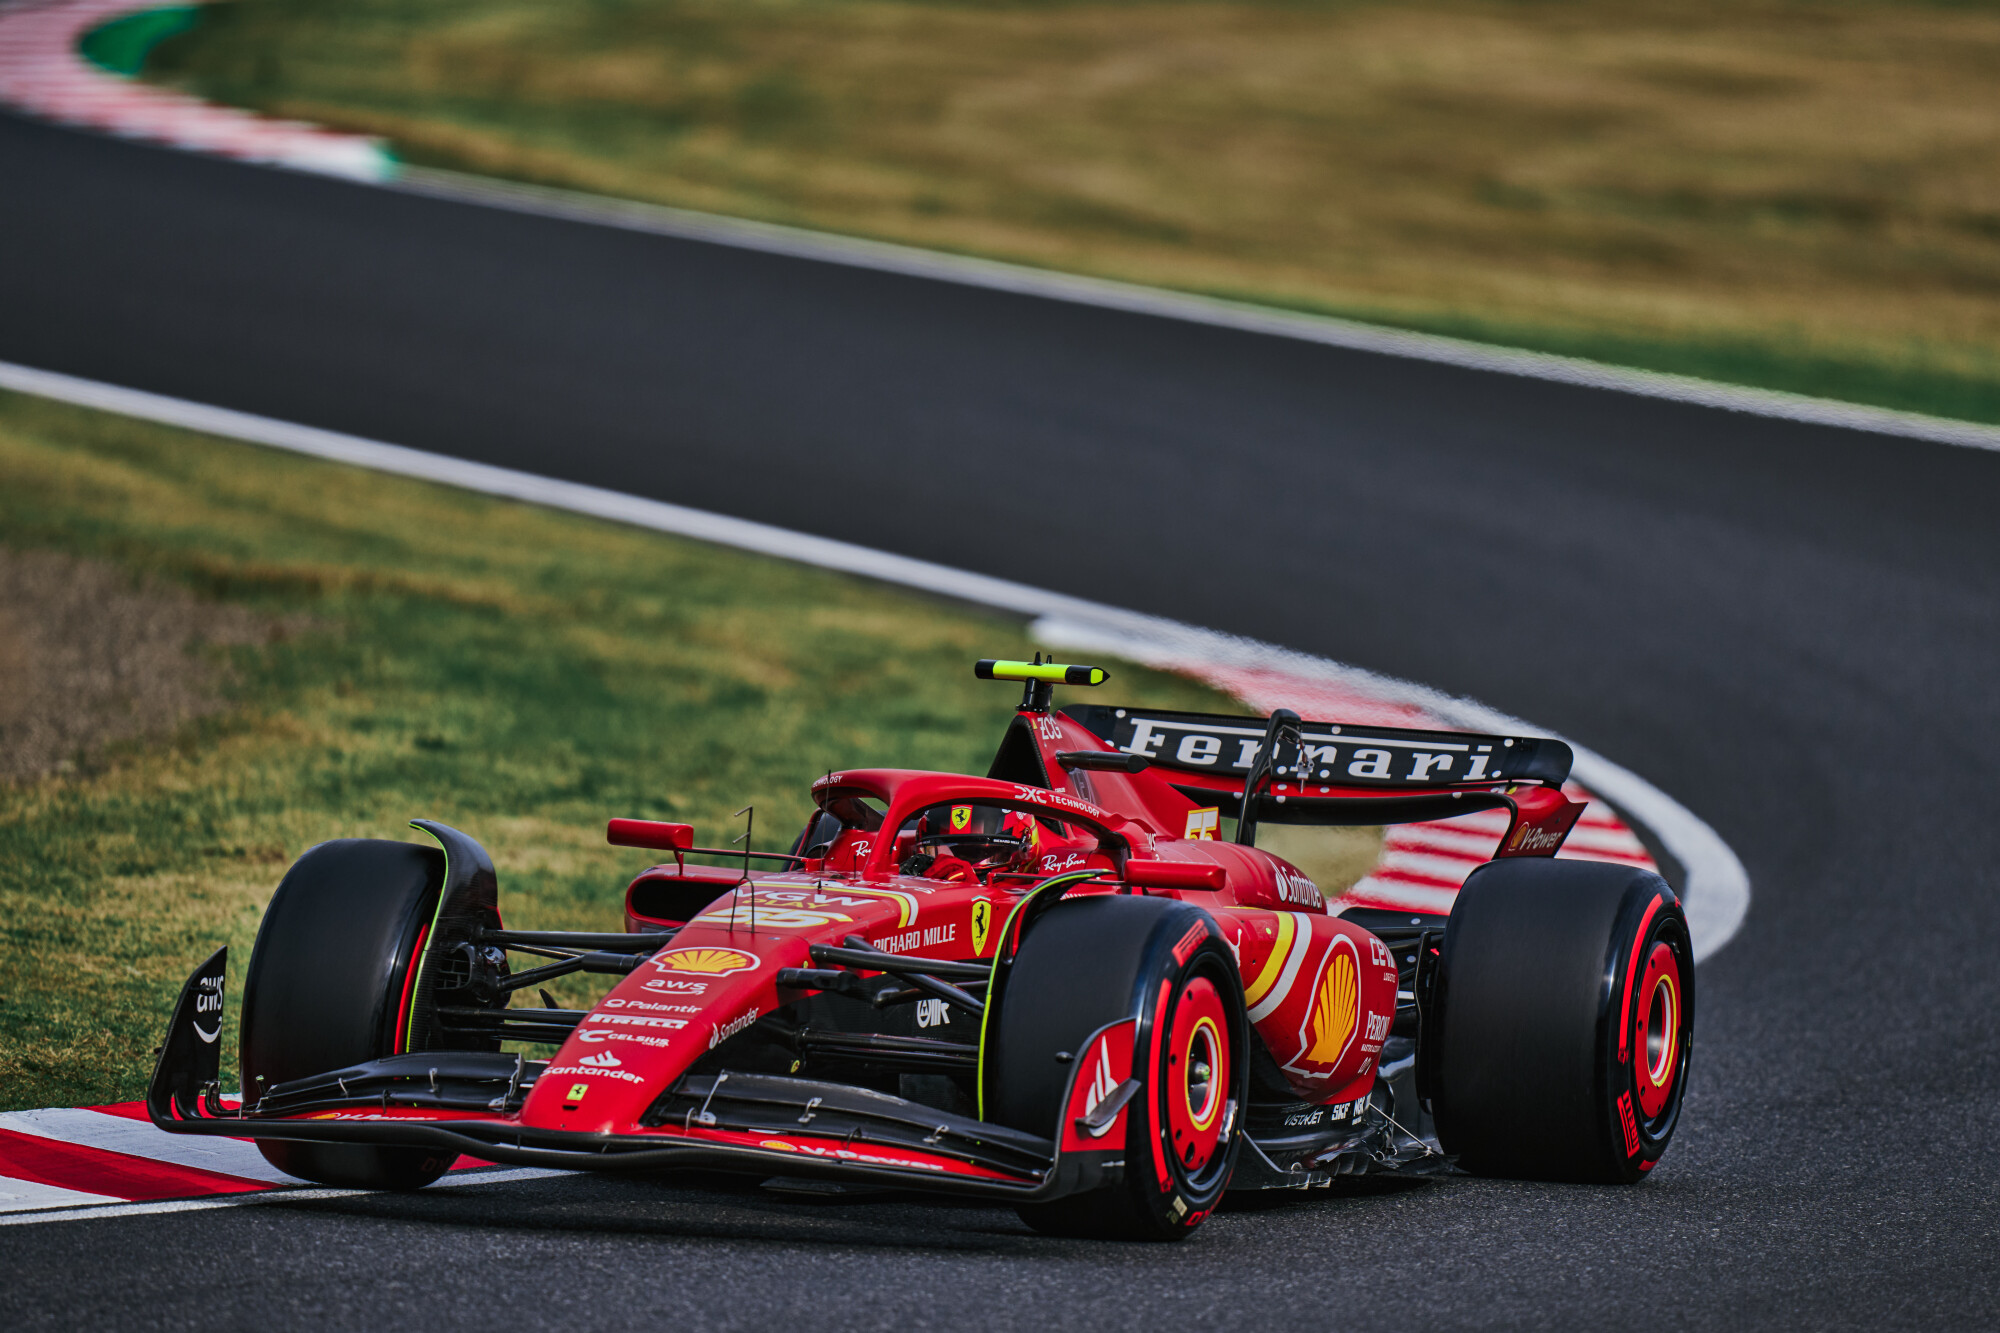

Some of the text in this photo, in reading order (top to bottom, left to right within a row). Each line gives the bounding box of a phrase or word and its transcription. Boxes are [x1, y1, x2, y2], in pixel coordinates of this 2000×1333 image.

[1119, 718, 1494, 782] Ferrari
[1014, 785, 1100, 818] DXC TECHNOLOGY
[1519, 827, 1563, 850] V-Power
[1041, 853, 1086, 872] Ray-Ban
[731, 889, 879, 907] VGW
[742, 898, 831, 909] PLAY
[690, 906, 854, 928] 55
[923, 923, 957, 947] MILLE
[645, 979, 709, 991] aws
[626, 1001, 702, 1014] Palantir
[588, 1013, 689, 1030] PIRELLI
[718, 1007, 760, 1045] Santander
[607, 1033, 670, 1045] CELSIUS
[540, 1066, 645, 1084] Santander
[1332, 1103, 1351, 1121] SKF
[800, 1145, 943, 1171] V-Power
